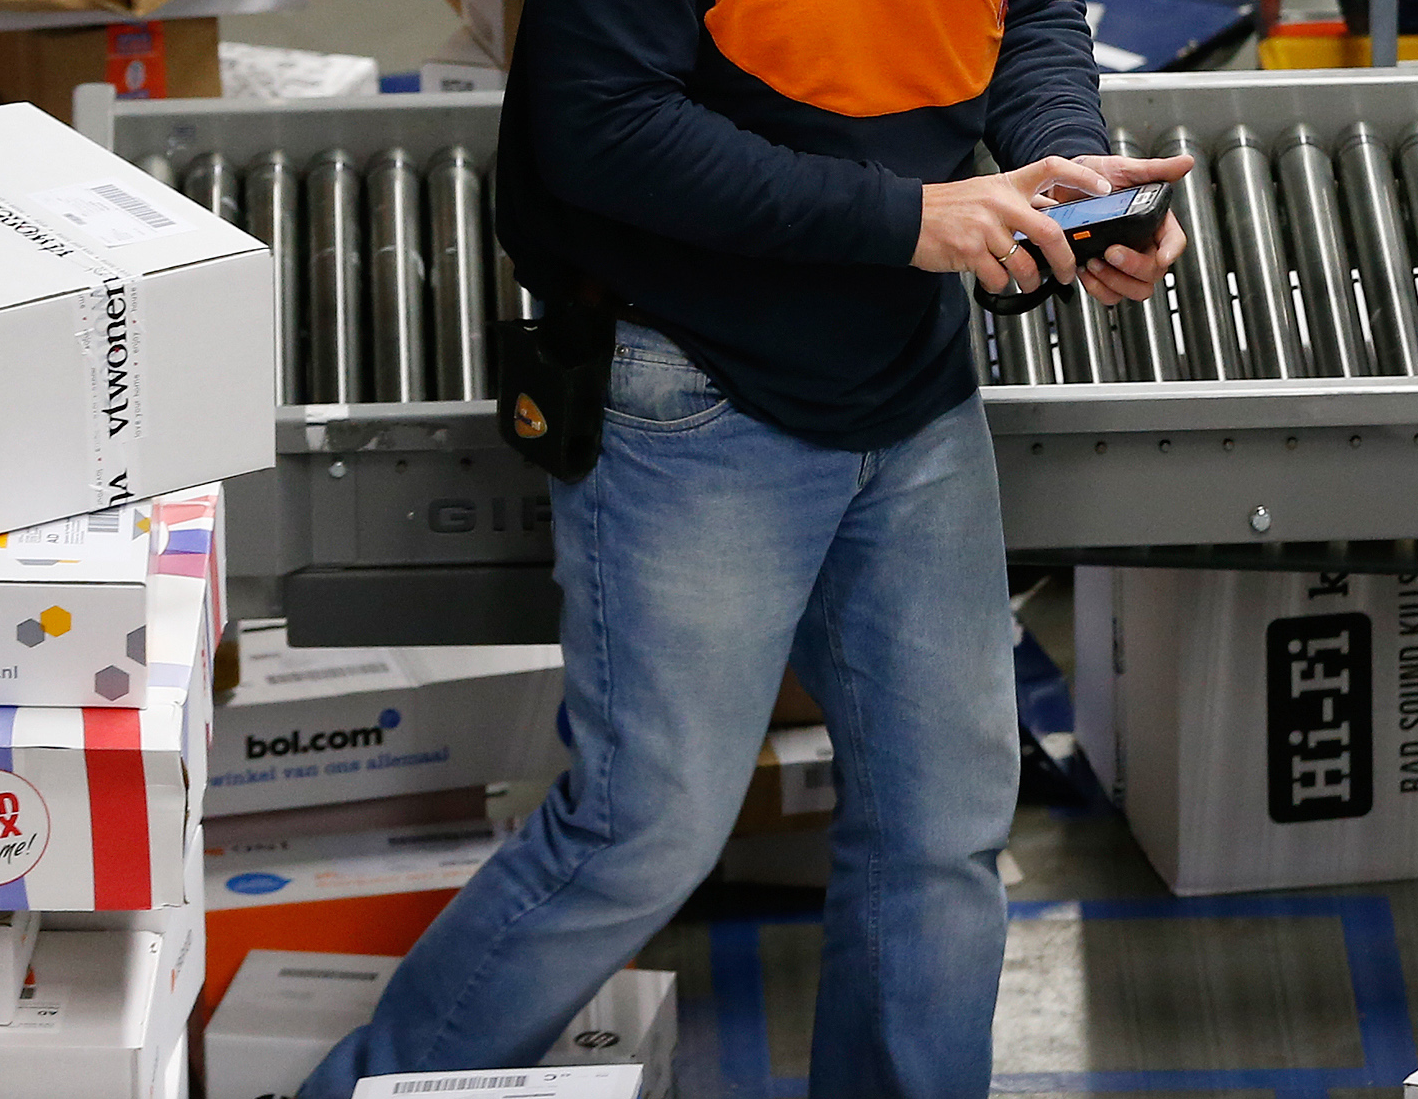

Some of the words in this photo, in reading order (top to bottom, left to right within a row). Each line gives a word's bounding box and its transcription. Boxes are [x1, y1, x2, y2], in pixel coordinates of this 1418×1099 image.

[428, 497, 552, 534] GIP
[1287, 631, 1351, 805] Hi-Fi
[245, 725, 383, 760] bol.com
